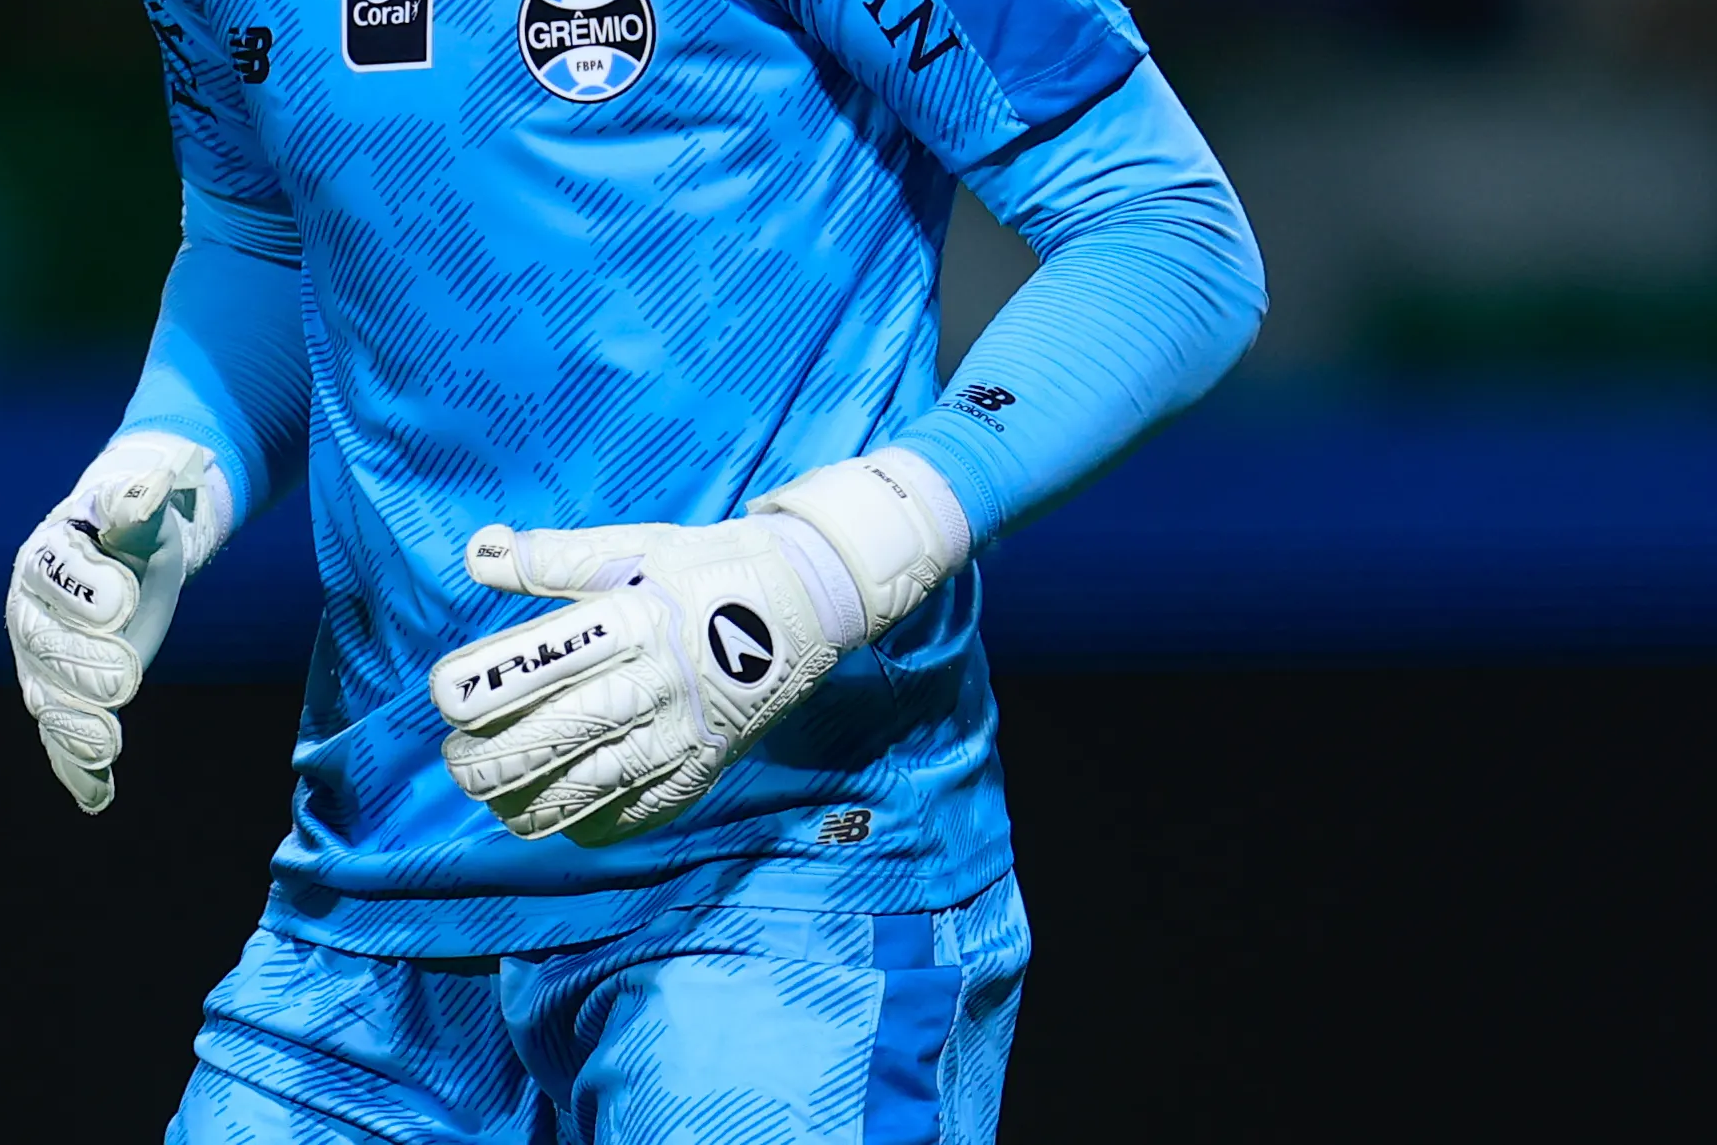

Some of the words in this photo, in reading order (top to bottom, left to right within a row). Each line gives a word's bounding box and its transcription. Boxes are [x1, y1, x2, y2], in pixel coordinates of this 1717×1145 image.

[353, 0, 411, 26] Coral
[528, 10, 644, 50] GRÊMIO
[576, 59, 604, 72] FBPA
[952, 400, 1005, 433] balance
